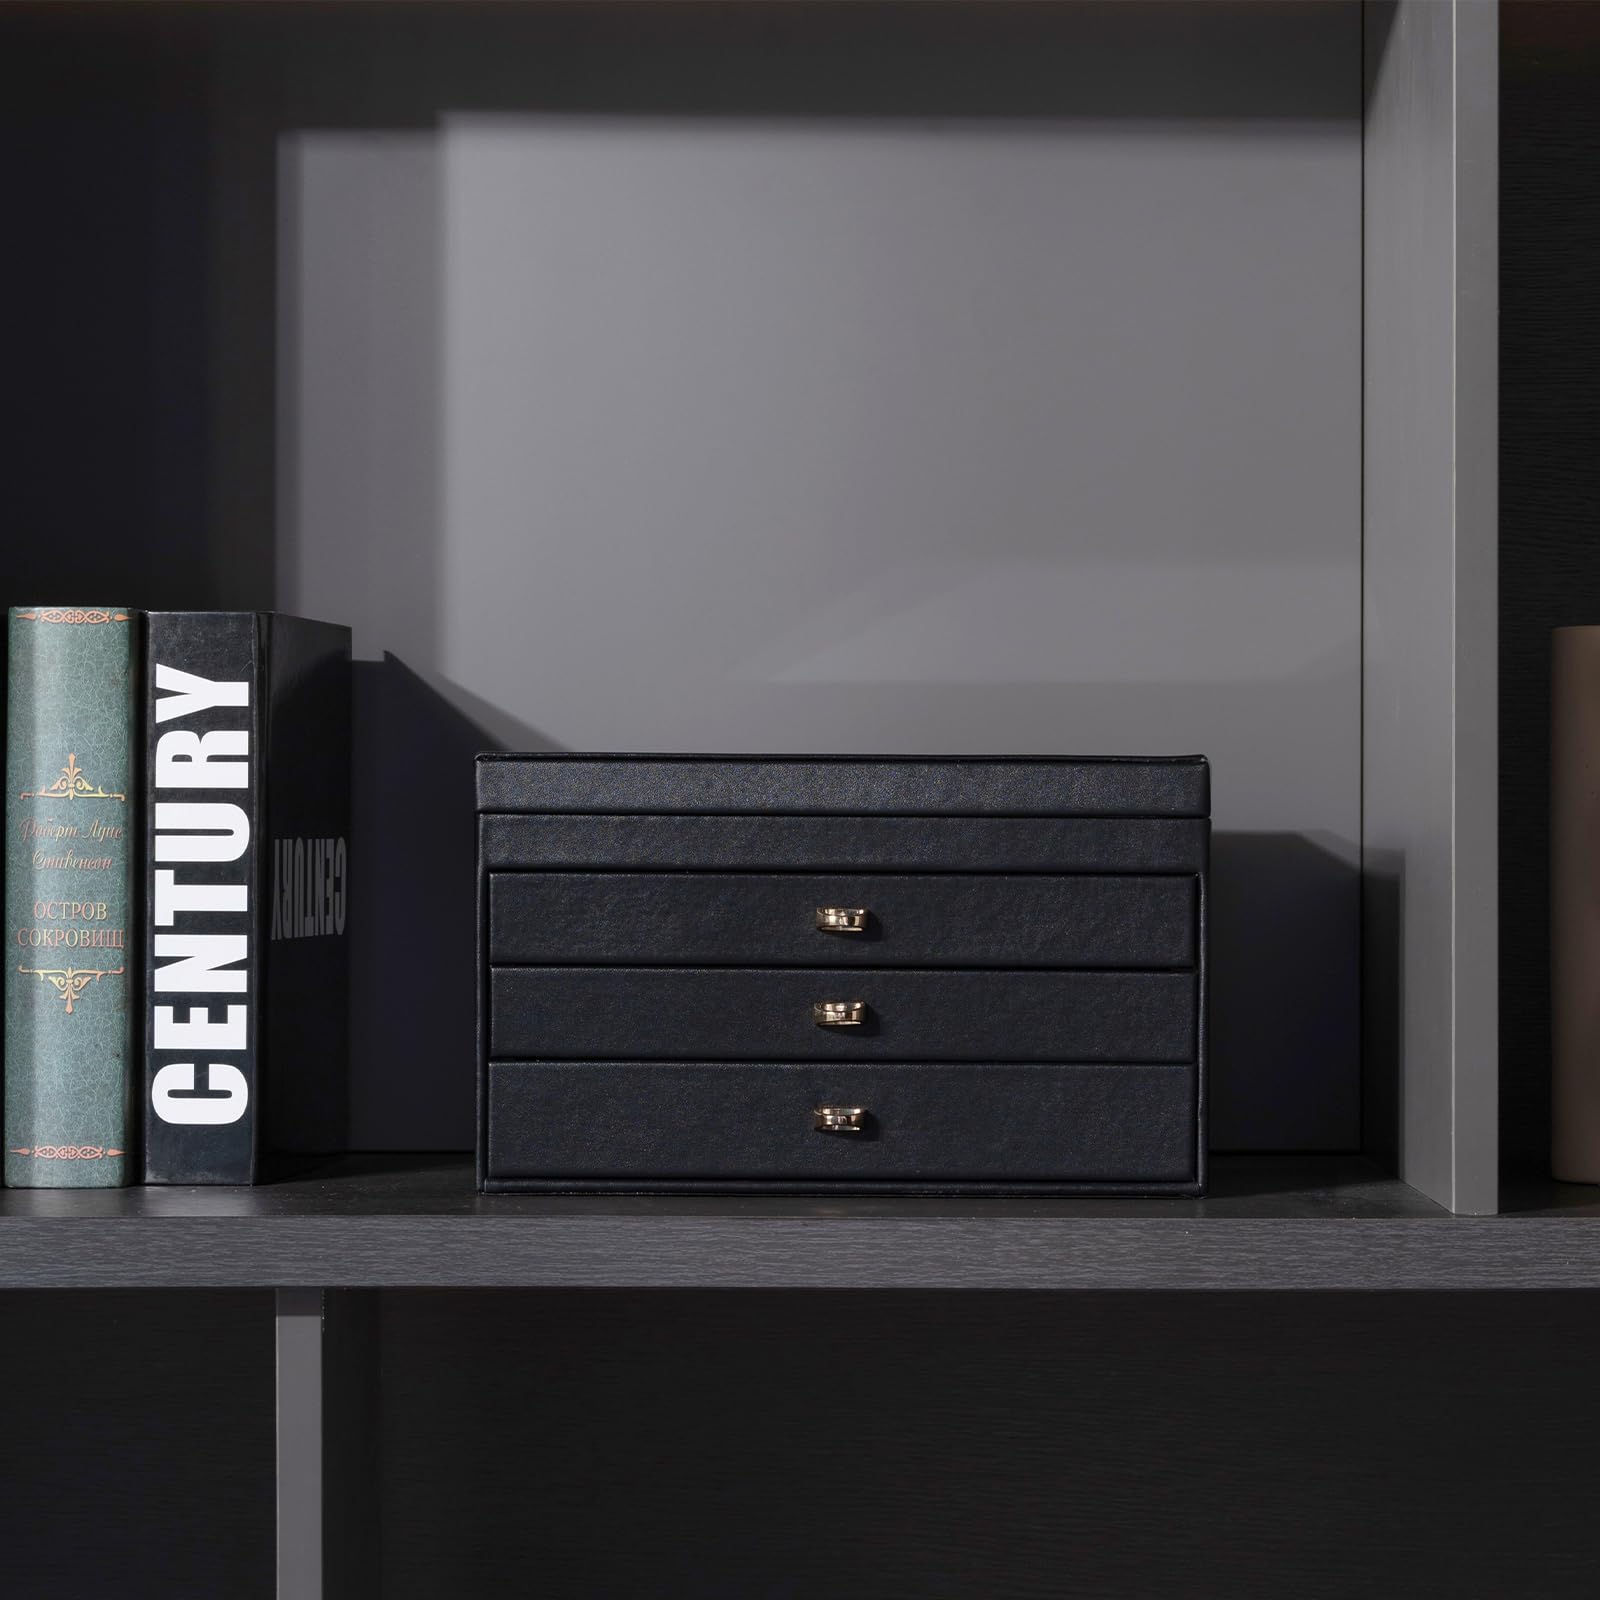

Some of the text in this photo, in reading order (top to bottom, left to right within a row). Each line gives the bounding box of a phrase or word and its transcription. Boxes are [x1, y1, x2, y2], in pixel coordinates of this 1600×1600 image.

[33, 901, 108, 920] ОСТРОВ
[151, 662, 250, 1125] CENTURY
[271, 836, 347, 941] CENTURY
[17, 928, 125, 949] СОКРОВИЩ
